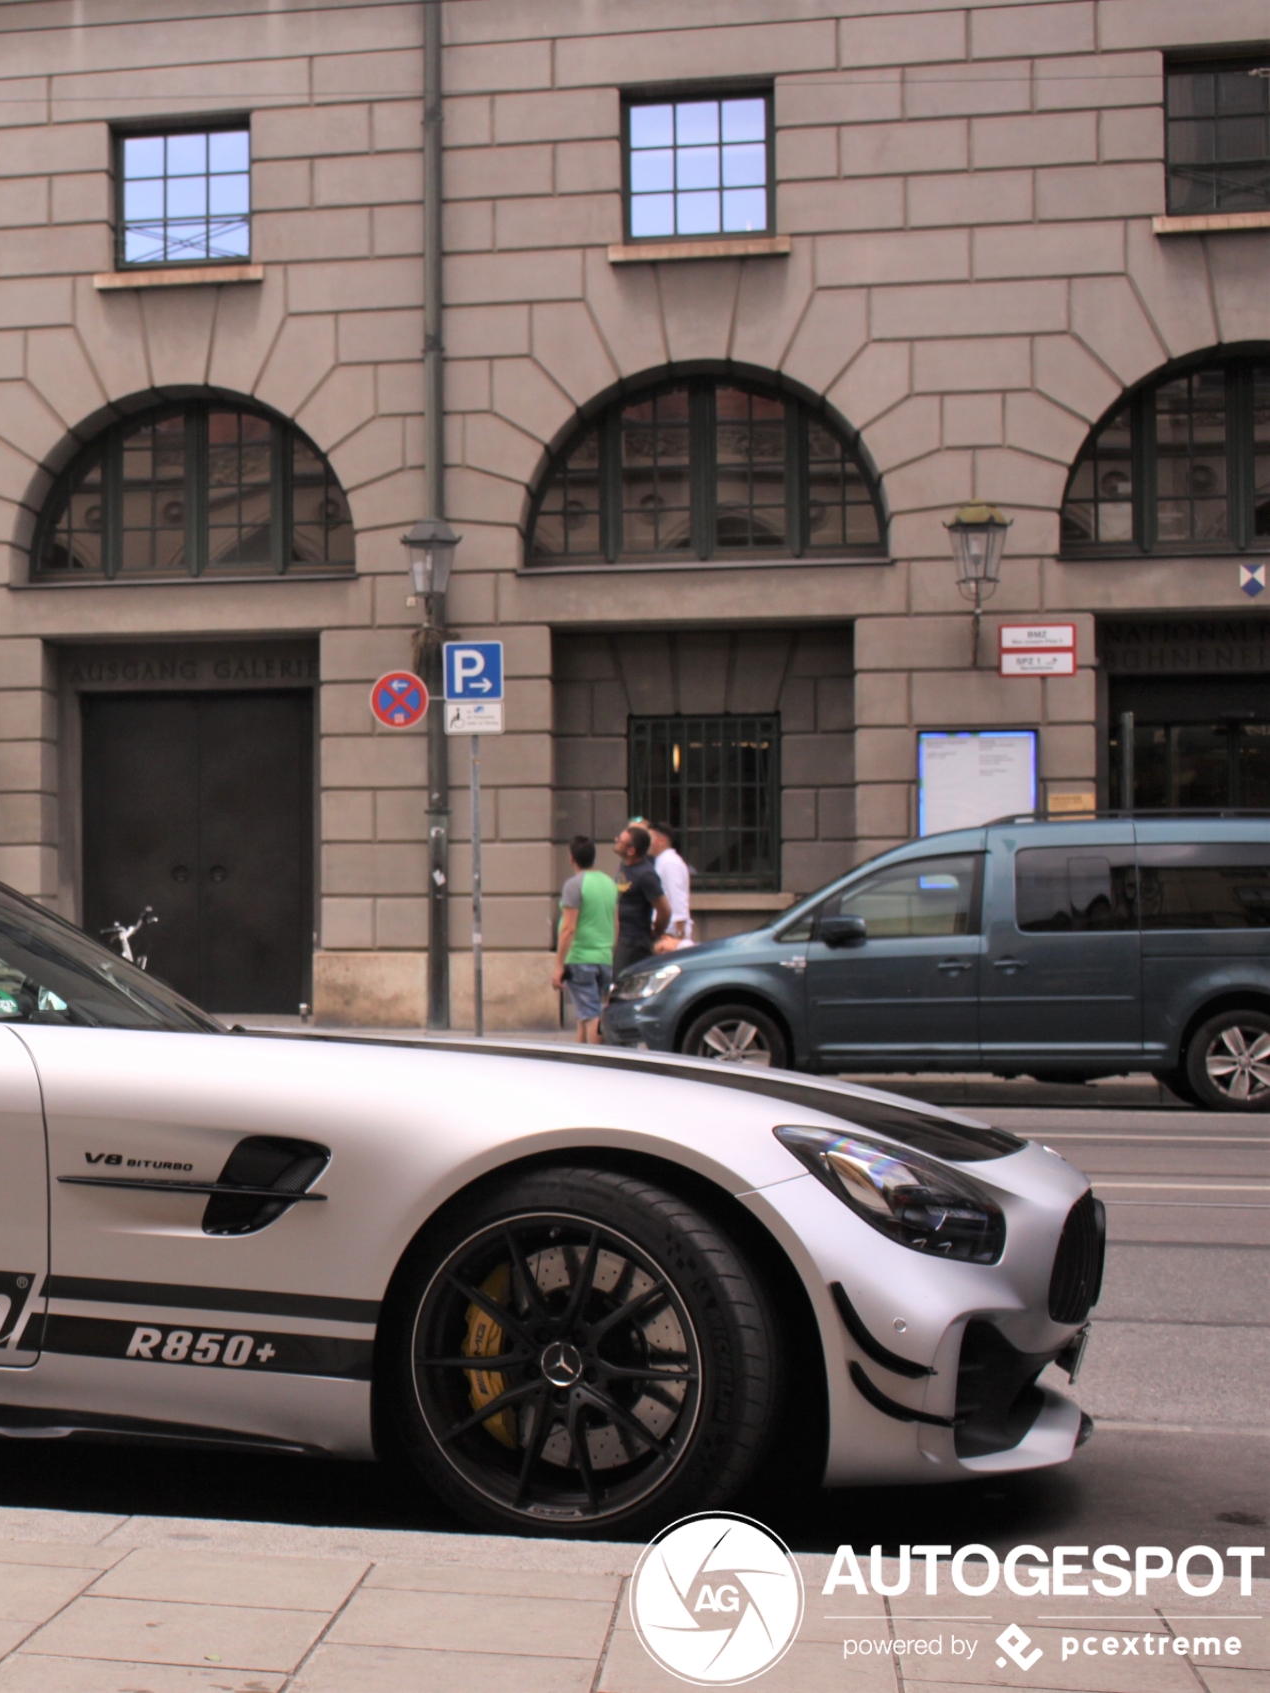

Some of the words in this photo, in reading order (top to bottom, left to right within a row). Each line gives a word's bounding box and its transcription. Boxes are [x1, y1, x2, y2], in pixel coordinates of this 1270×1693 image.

[1027, 630, 1047, 639] BMZ
[69, 660, 197, 683] AUSGANG
[214, 658, 317, 680] GALERIE
[454, 649, 485, 693] P
[1016, 657, 1034, 666] SPZ
[85, 1152, 123, 1166] V8
[126, 1159, 194, 1172] BITURBO
[125, 1326, 276, 1367] R850+
